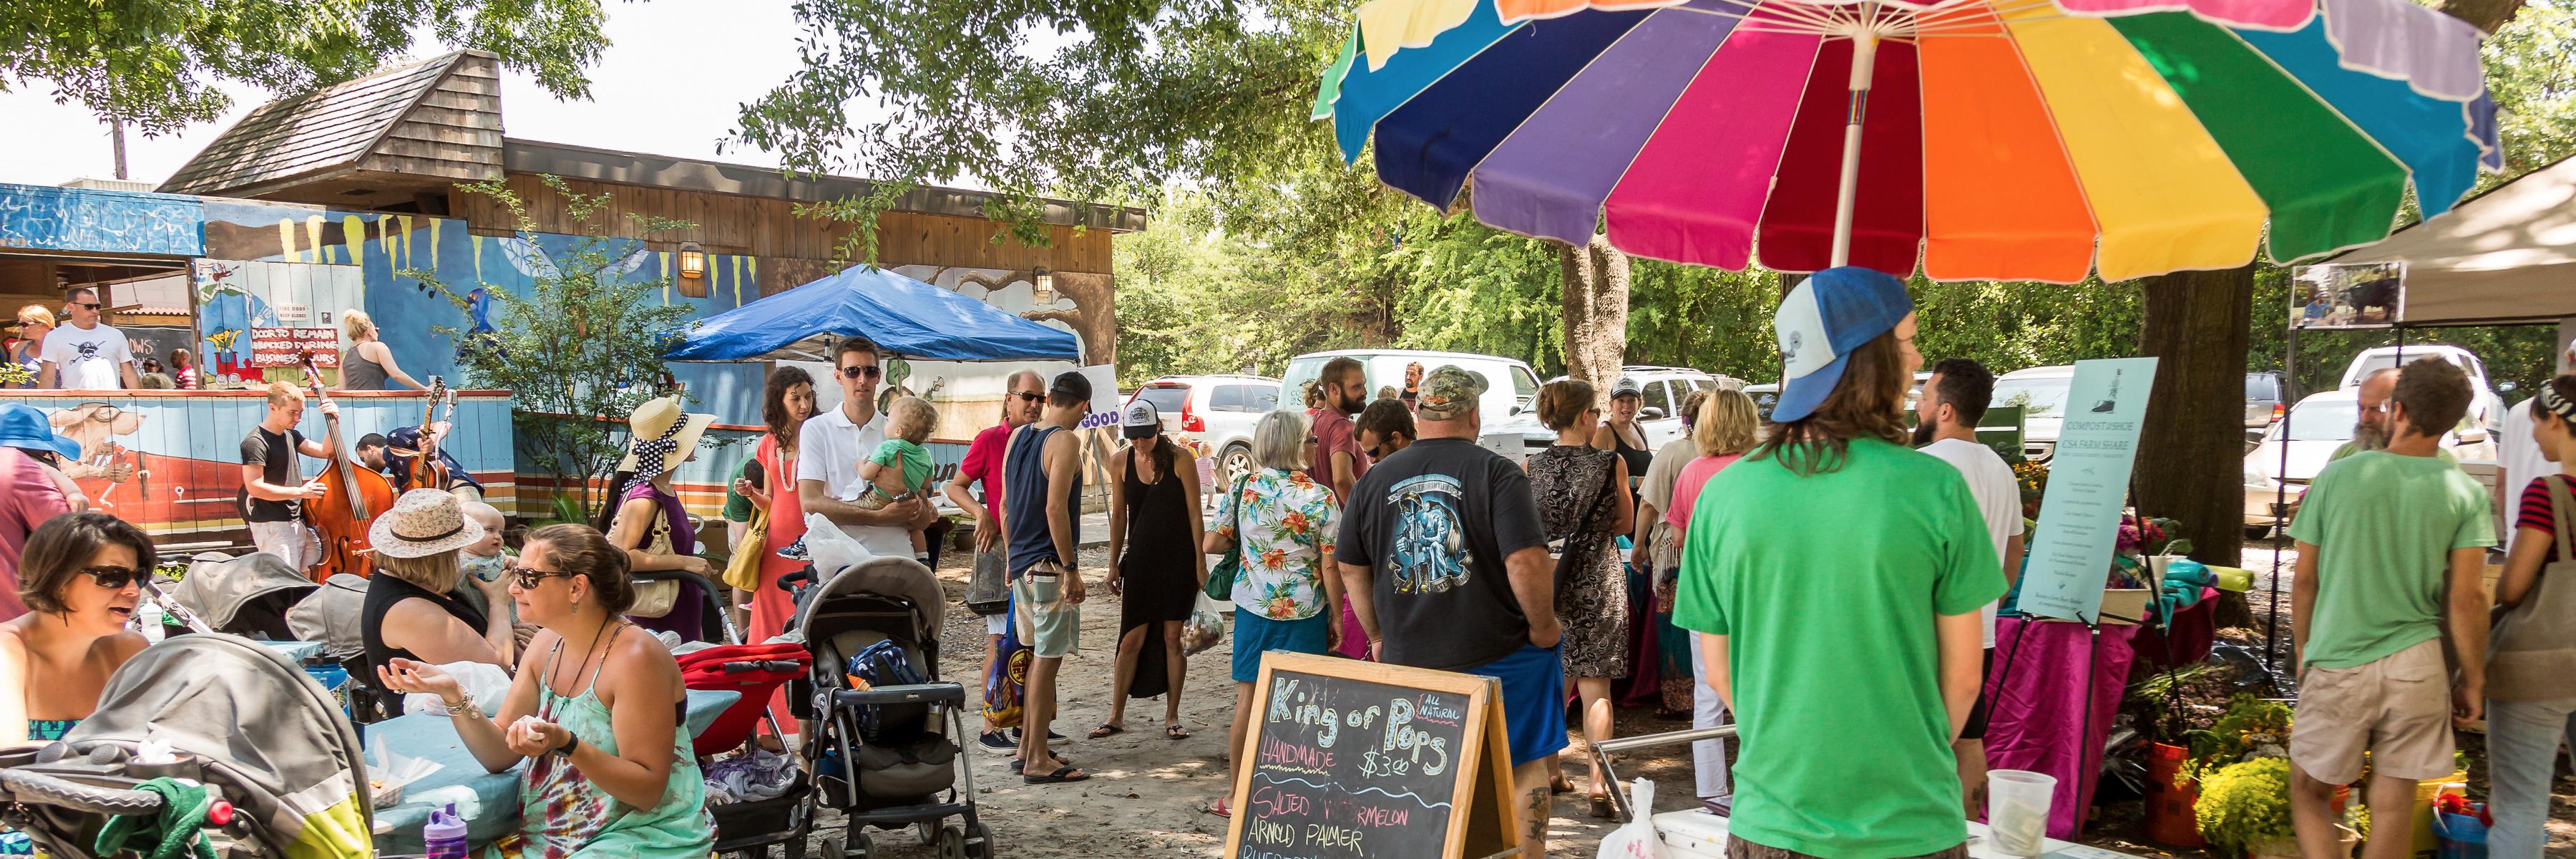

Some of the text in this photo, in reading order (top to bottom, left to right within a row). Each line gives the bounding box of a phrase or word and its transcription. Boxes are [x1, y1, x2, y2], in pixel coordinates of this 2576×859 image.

[251, 329, 335, 339] DOOR TO REMAIN
[130, 338, 153, 354] OWS
[255, 353, 300, 364] BUSINESS
[1081, 411, 1119, 428] GOOD
[1425, 694, 1440, 705] ALL
[1419, 706, 1460, 720] NATURAL
[1270, 677, 1448, 776] King of Pops
[1261, 734, 1337, 770] HANDMADE
[1252, 786, 1310, 819] SALTED
[1247, 815, 1295, 848] ARNOLD
[1305, 823, 1364, 858] PALMER
